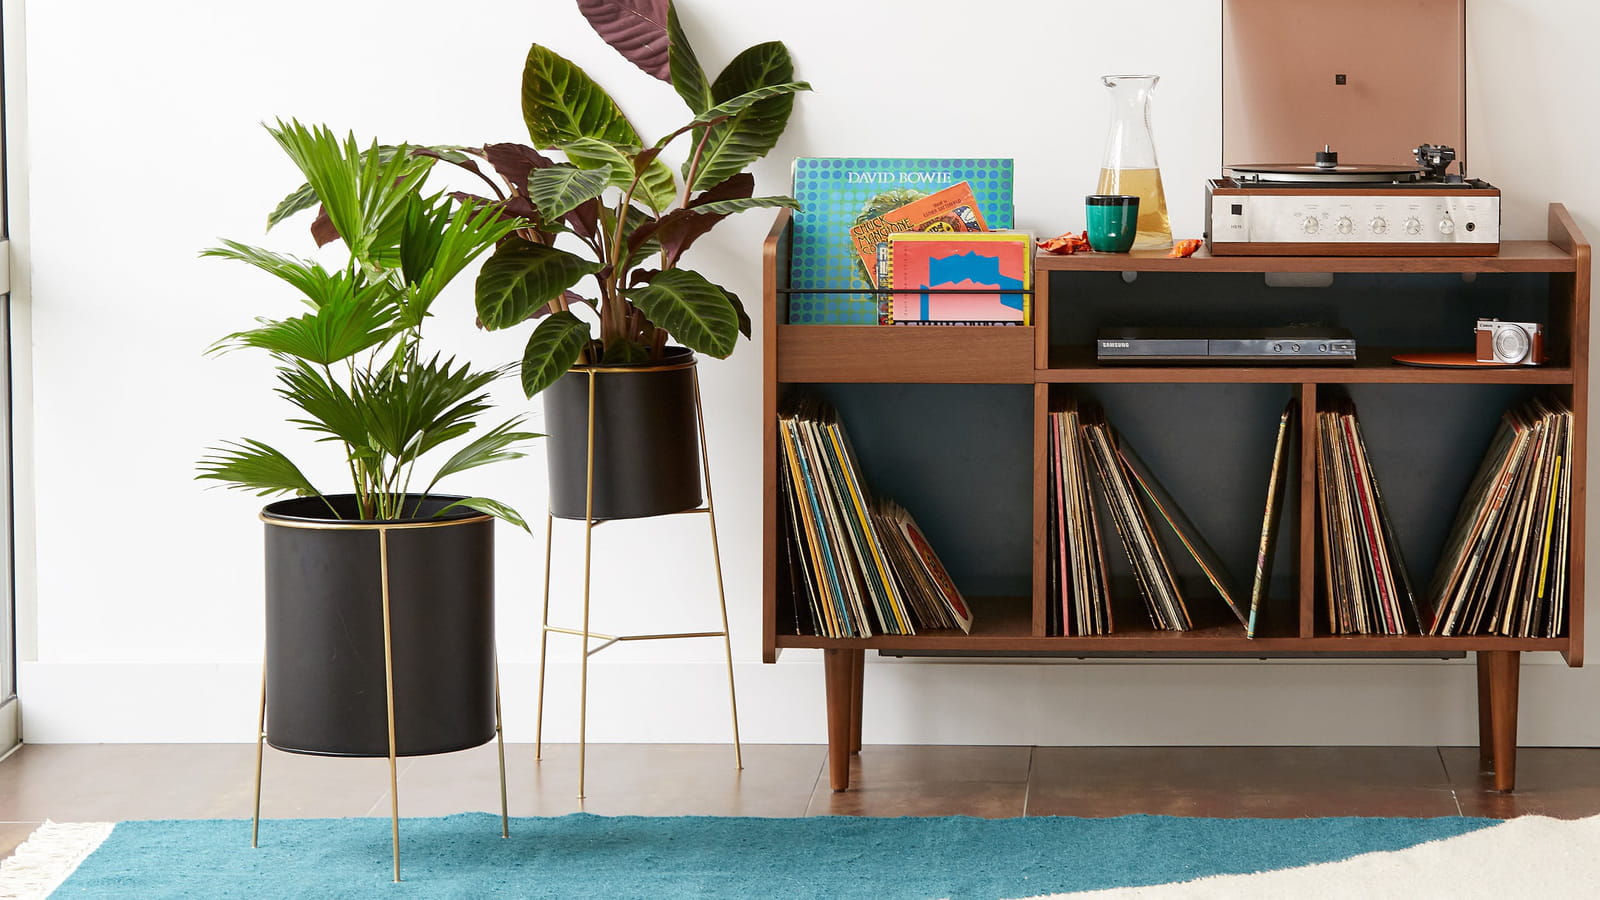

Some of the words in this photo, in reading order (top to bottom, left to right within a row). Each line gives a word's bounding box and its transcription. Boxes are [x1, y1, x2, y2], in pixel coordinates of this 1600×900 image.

[847, 171, 896, 184] DAVID
[899, 171, 952, 184] BOWIE
[853, 215, 889, 236] CHUCK
[858, 218, 915, 249] MANGIONE
